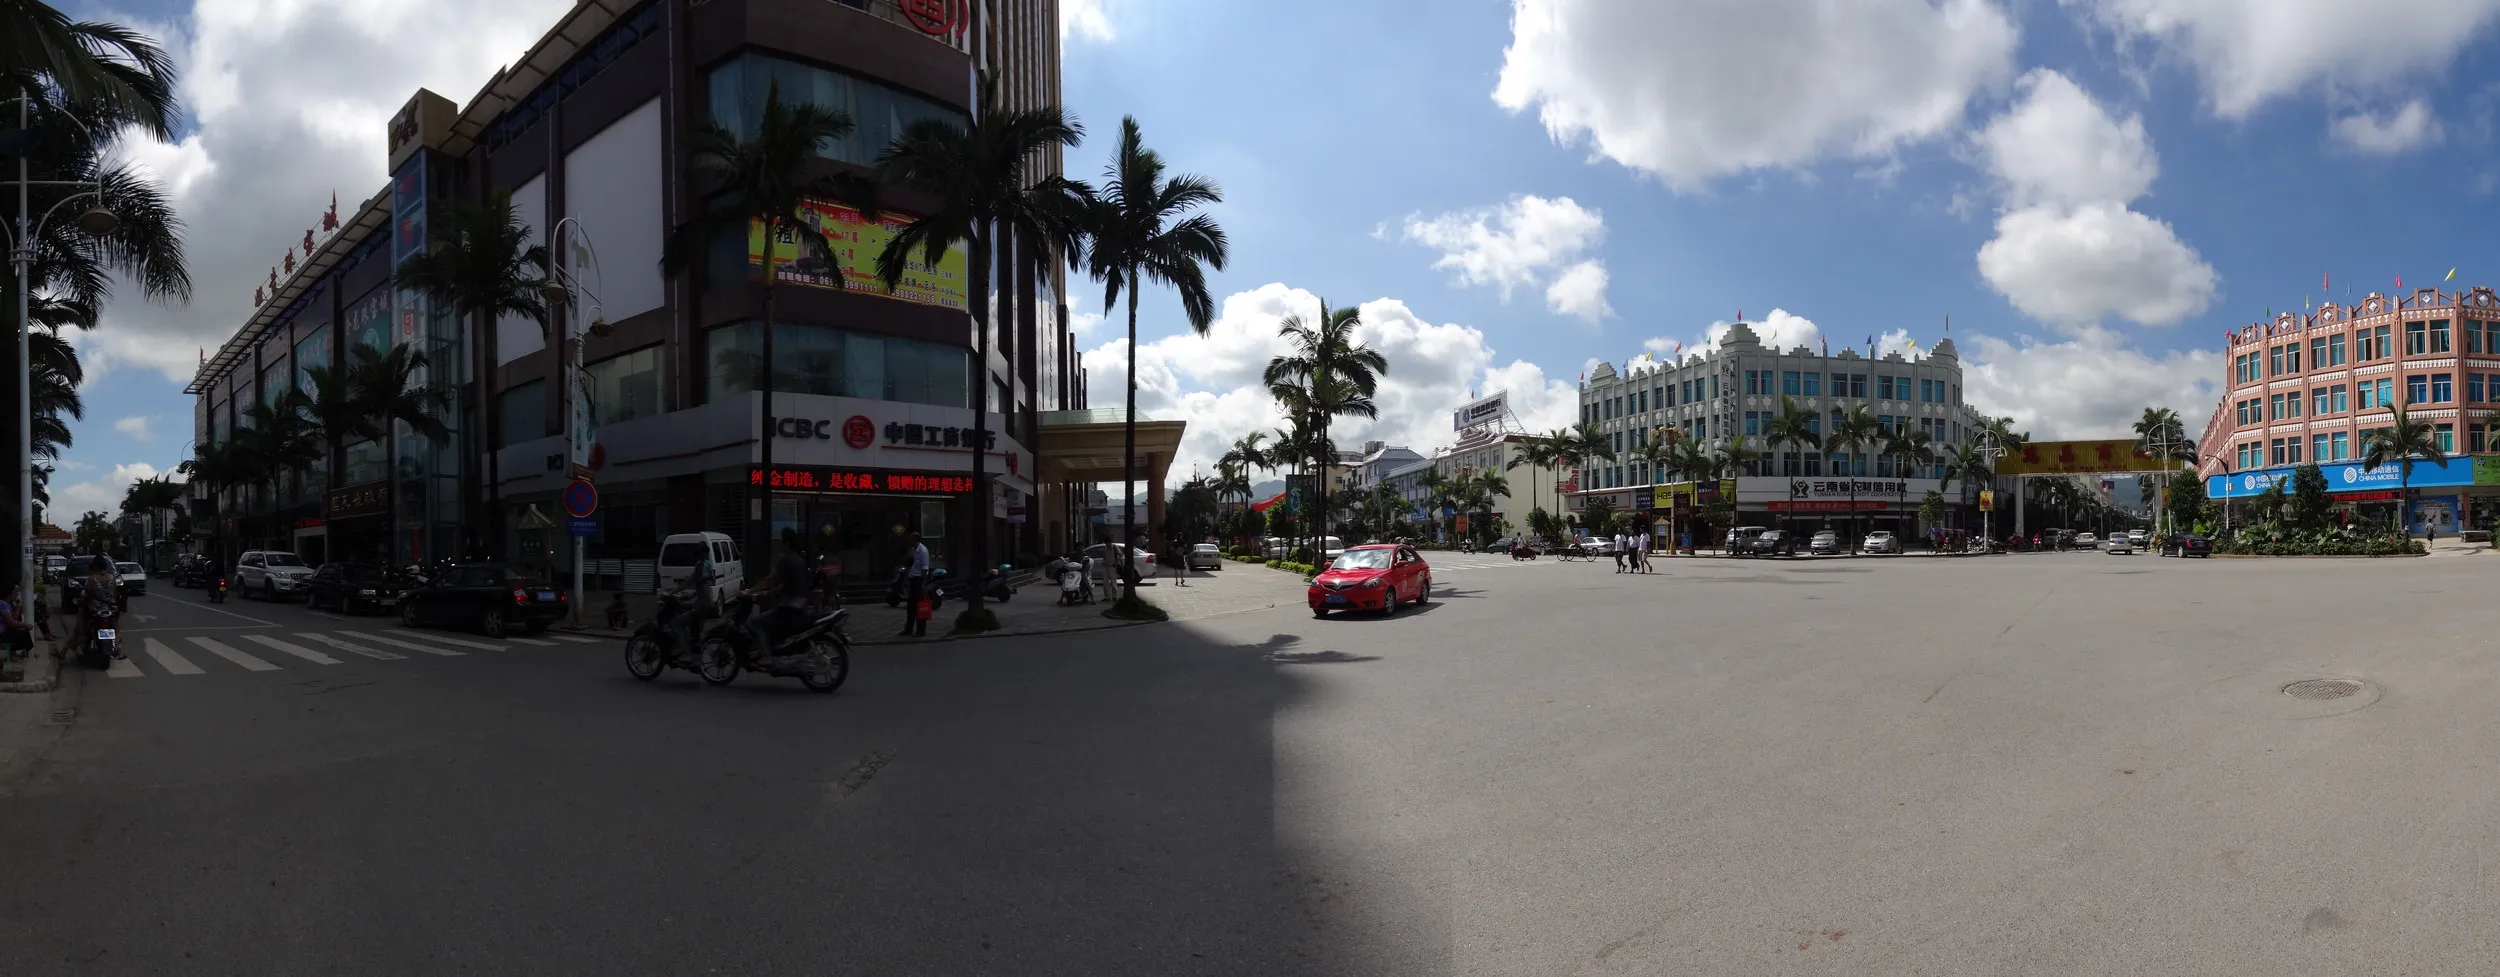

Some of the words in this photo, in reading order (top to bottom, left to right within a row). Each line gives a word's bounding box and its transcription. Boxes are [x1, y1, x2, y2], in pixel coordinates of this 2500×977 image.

[771, 417, 831, 439] ICBC
[885, 421, 996, 450] 中国工商银行
[2358, 474, 2377, 482] CHINA
[2377, 473, 2399, 481] MOBILE
